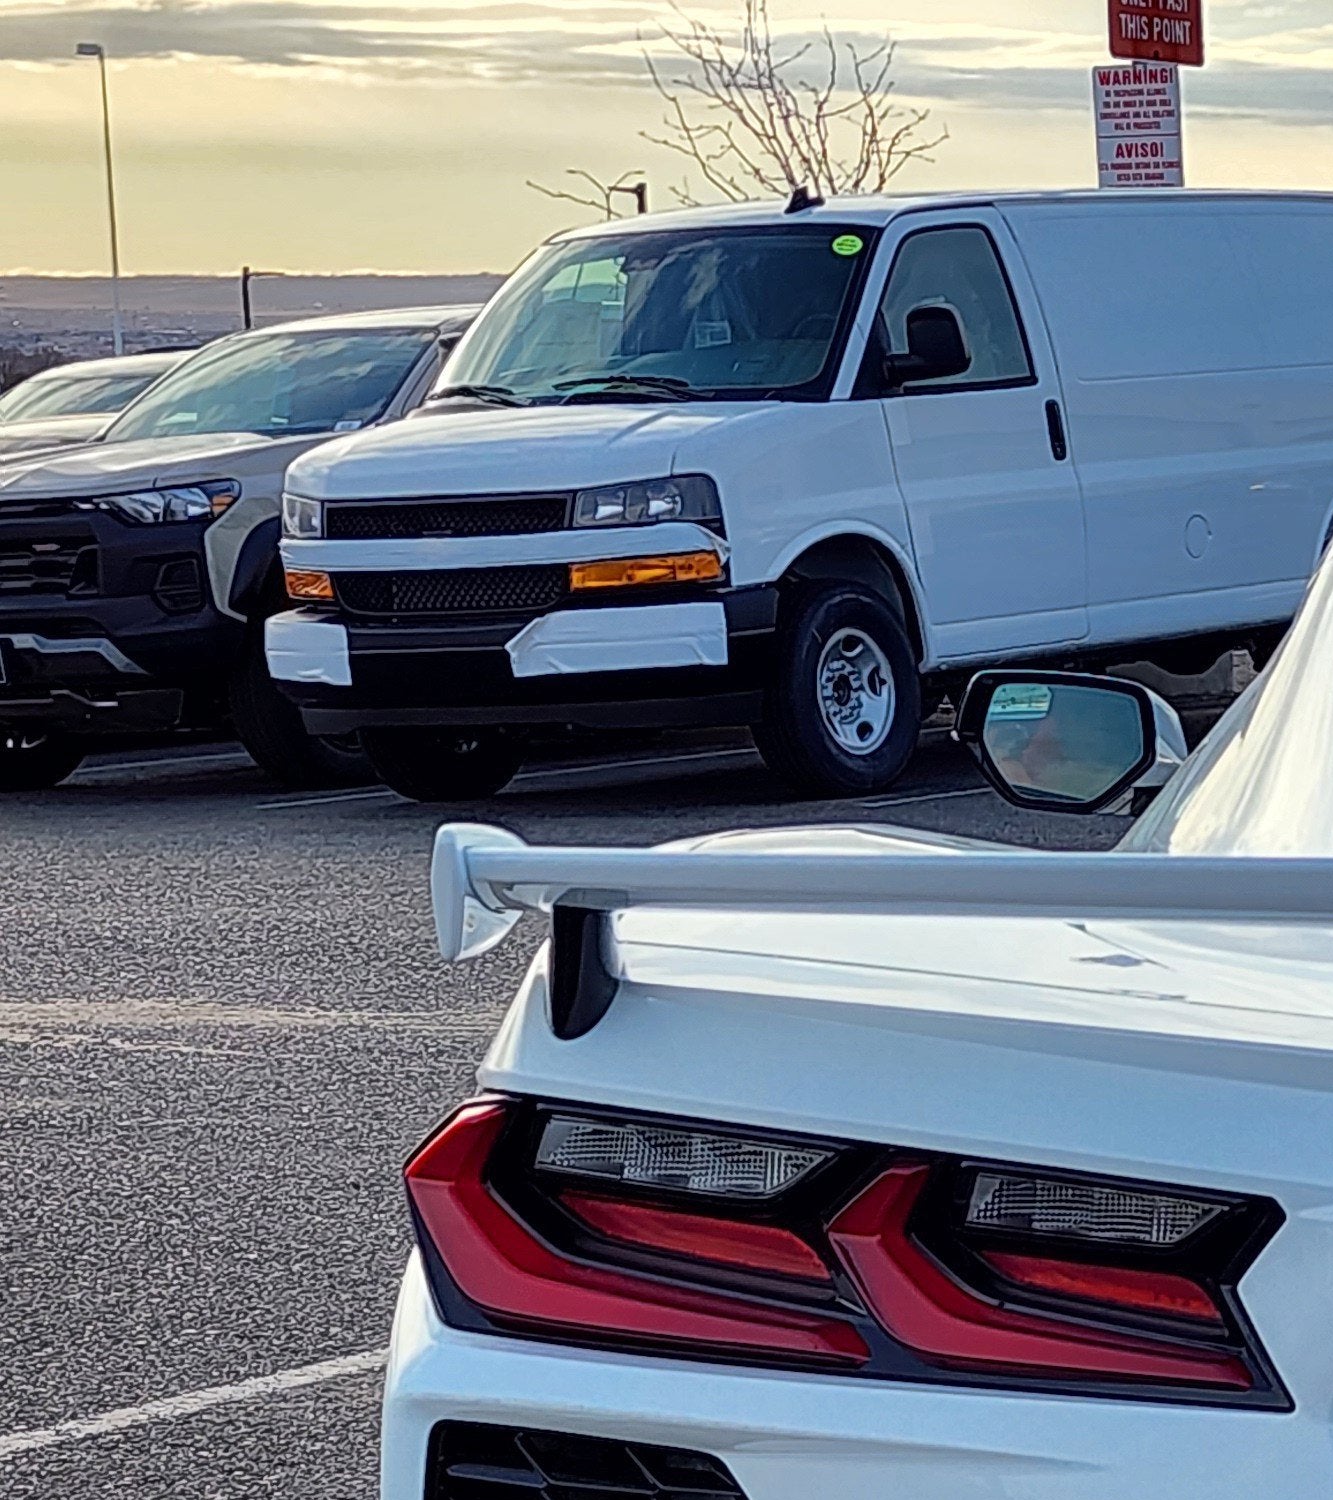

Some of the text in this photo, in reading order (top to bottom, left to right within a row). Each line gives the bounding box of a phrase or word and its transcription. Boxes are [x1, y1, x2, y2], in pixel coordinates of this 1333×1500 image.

[1119, 13, 1191, 46] THIS POINT
[1098, 67, 1173, 86] WARNING!
[1115, 141, 1164, 159] AVISO!
